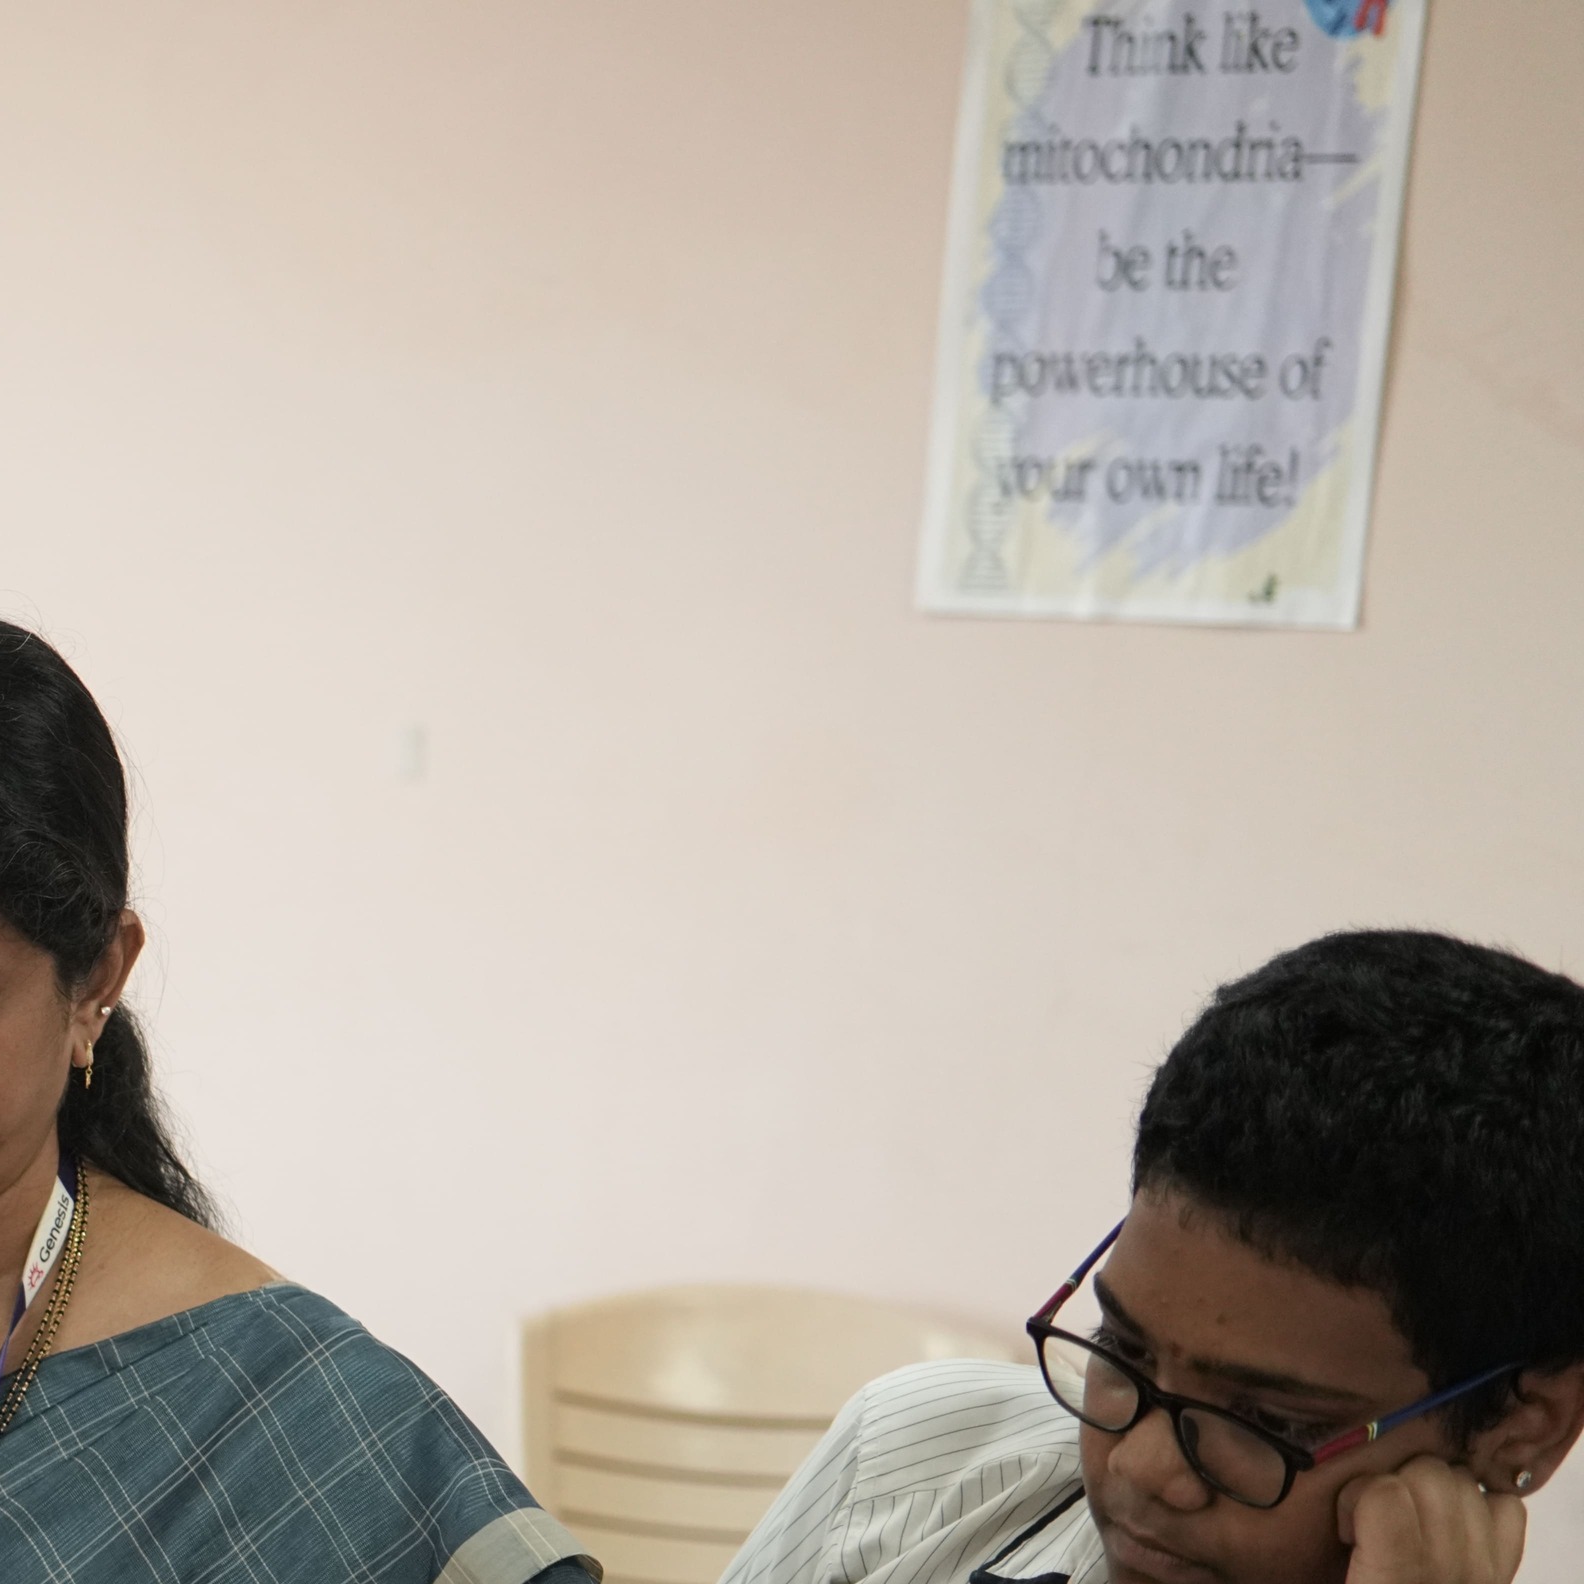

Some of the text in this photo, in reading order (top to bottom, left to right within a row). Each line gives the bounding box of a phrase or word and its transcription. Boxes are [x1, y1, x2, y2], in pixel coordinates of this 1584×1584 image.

[1082, 11, 1302, 77] Think like
[1096, 228, 1239, 292] be the
[991, 335, 1333, 406] powerhouse of
[1105, 455, 1201, 505] own
[1216, 442, 1301, 509] life!
[38, 1194, 70, 1263] Genesis
